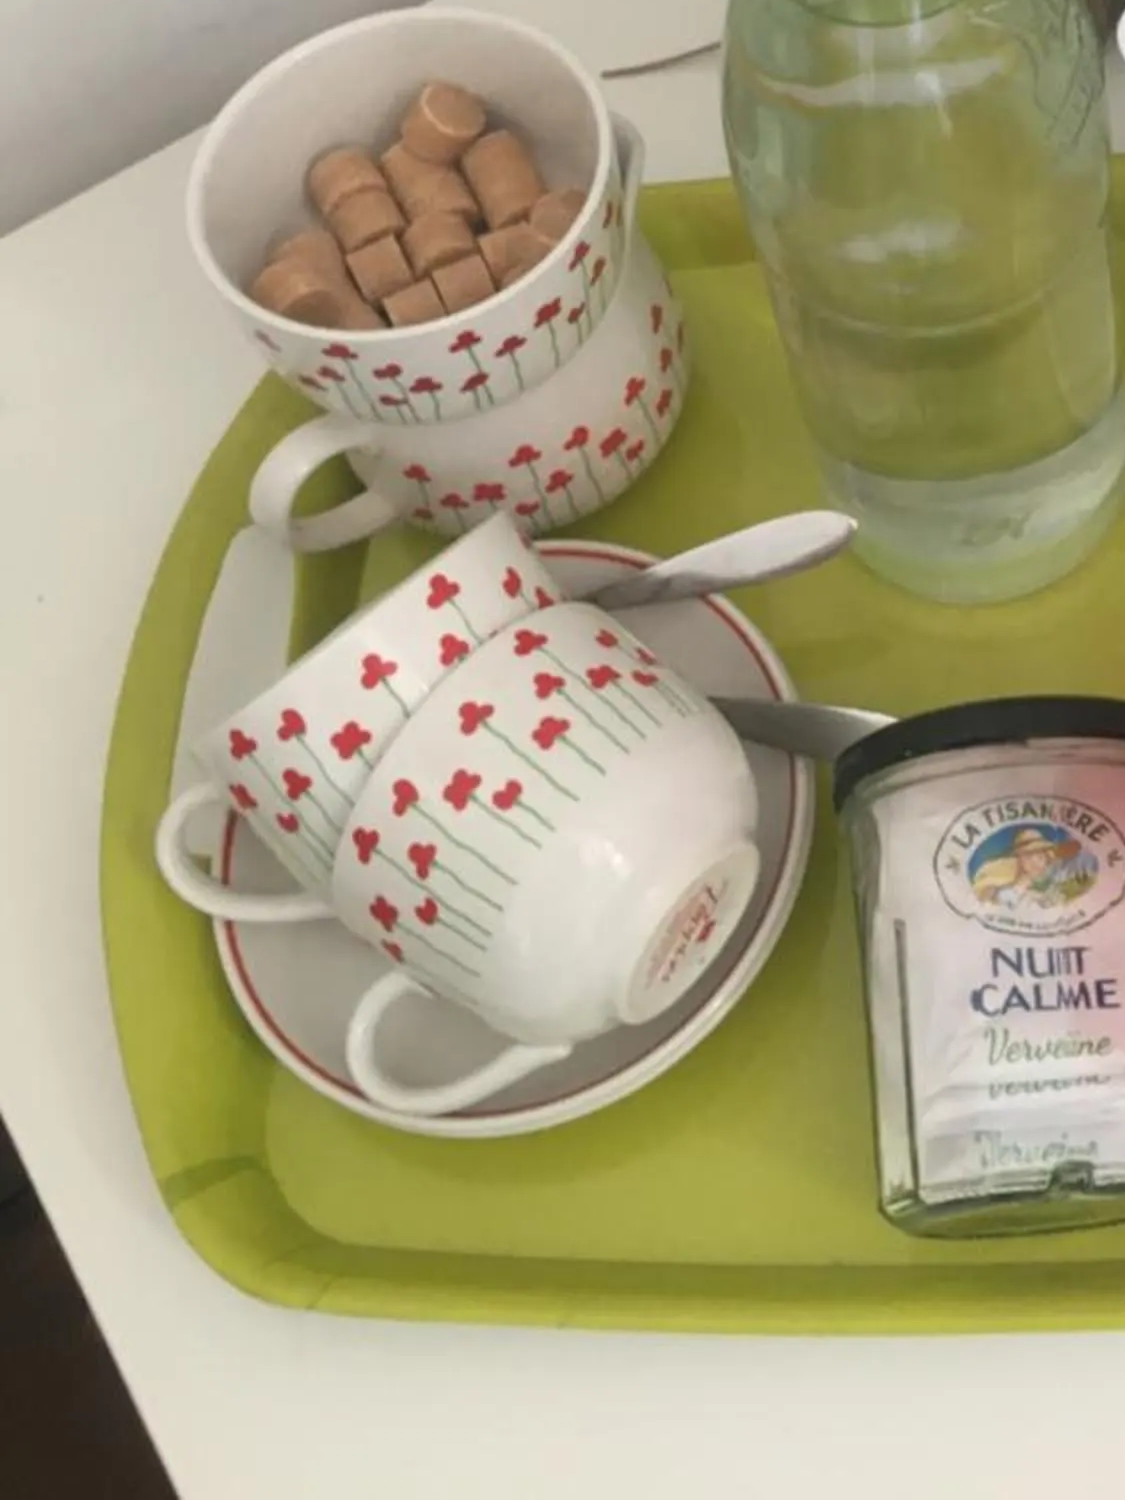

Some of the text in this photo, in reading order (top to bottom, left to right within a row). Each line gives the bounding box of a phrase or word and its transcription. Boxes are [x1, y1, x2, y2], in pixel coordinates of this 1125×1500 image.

[952, 825, 981, 849] LA
[991, 947, 1090, 979] NUIT
[970, 978, 1121, 1016] CALME
